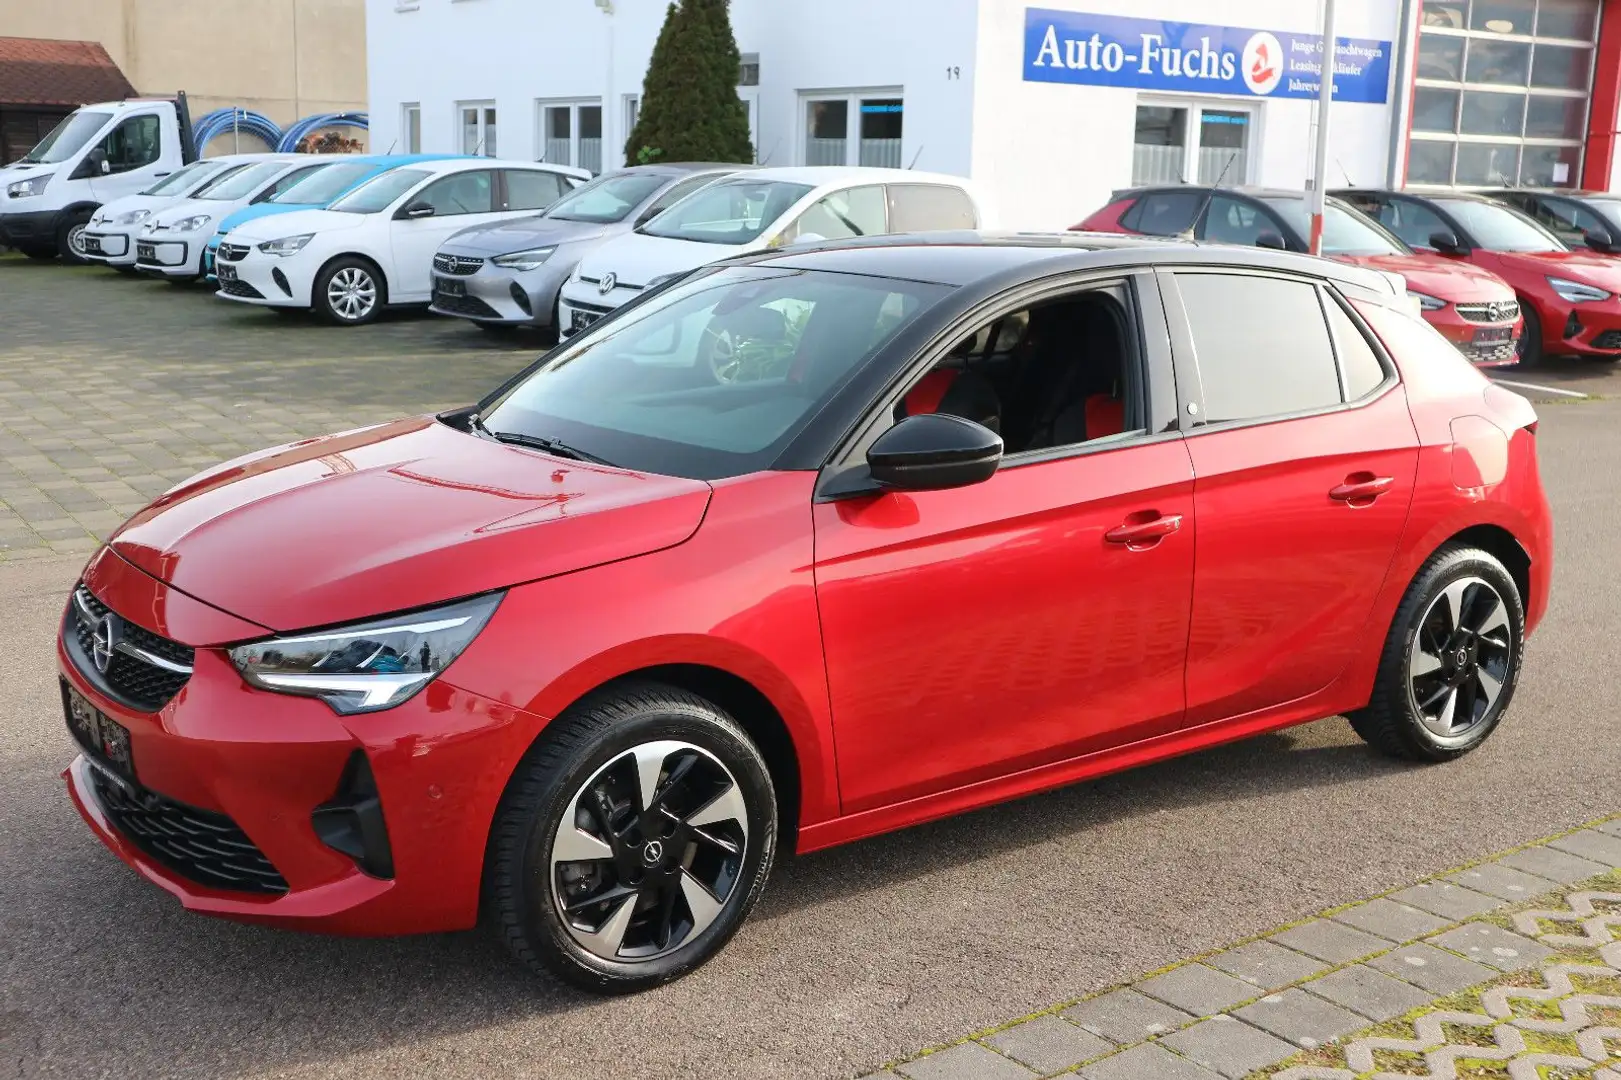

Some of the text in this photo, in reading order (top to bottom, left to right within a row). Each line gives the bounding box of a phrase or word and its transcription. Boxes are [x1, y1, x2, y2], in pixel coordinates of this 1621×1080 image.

[1033, 24, 1235, 80] Auto-Fuchs
[1291, 39, 1315, 54] Junge
[946, 66, 960, 80] 19
